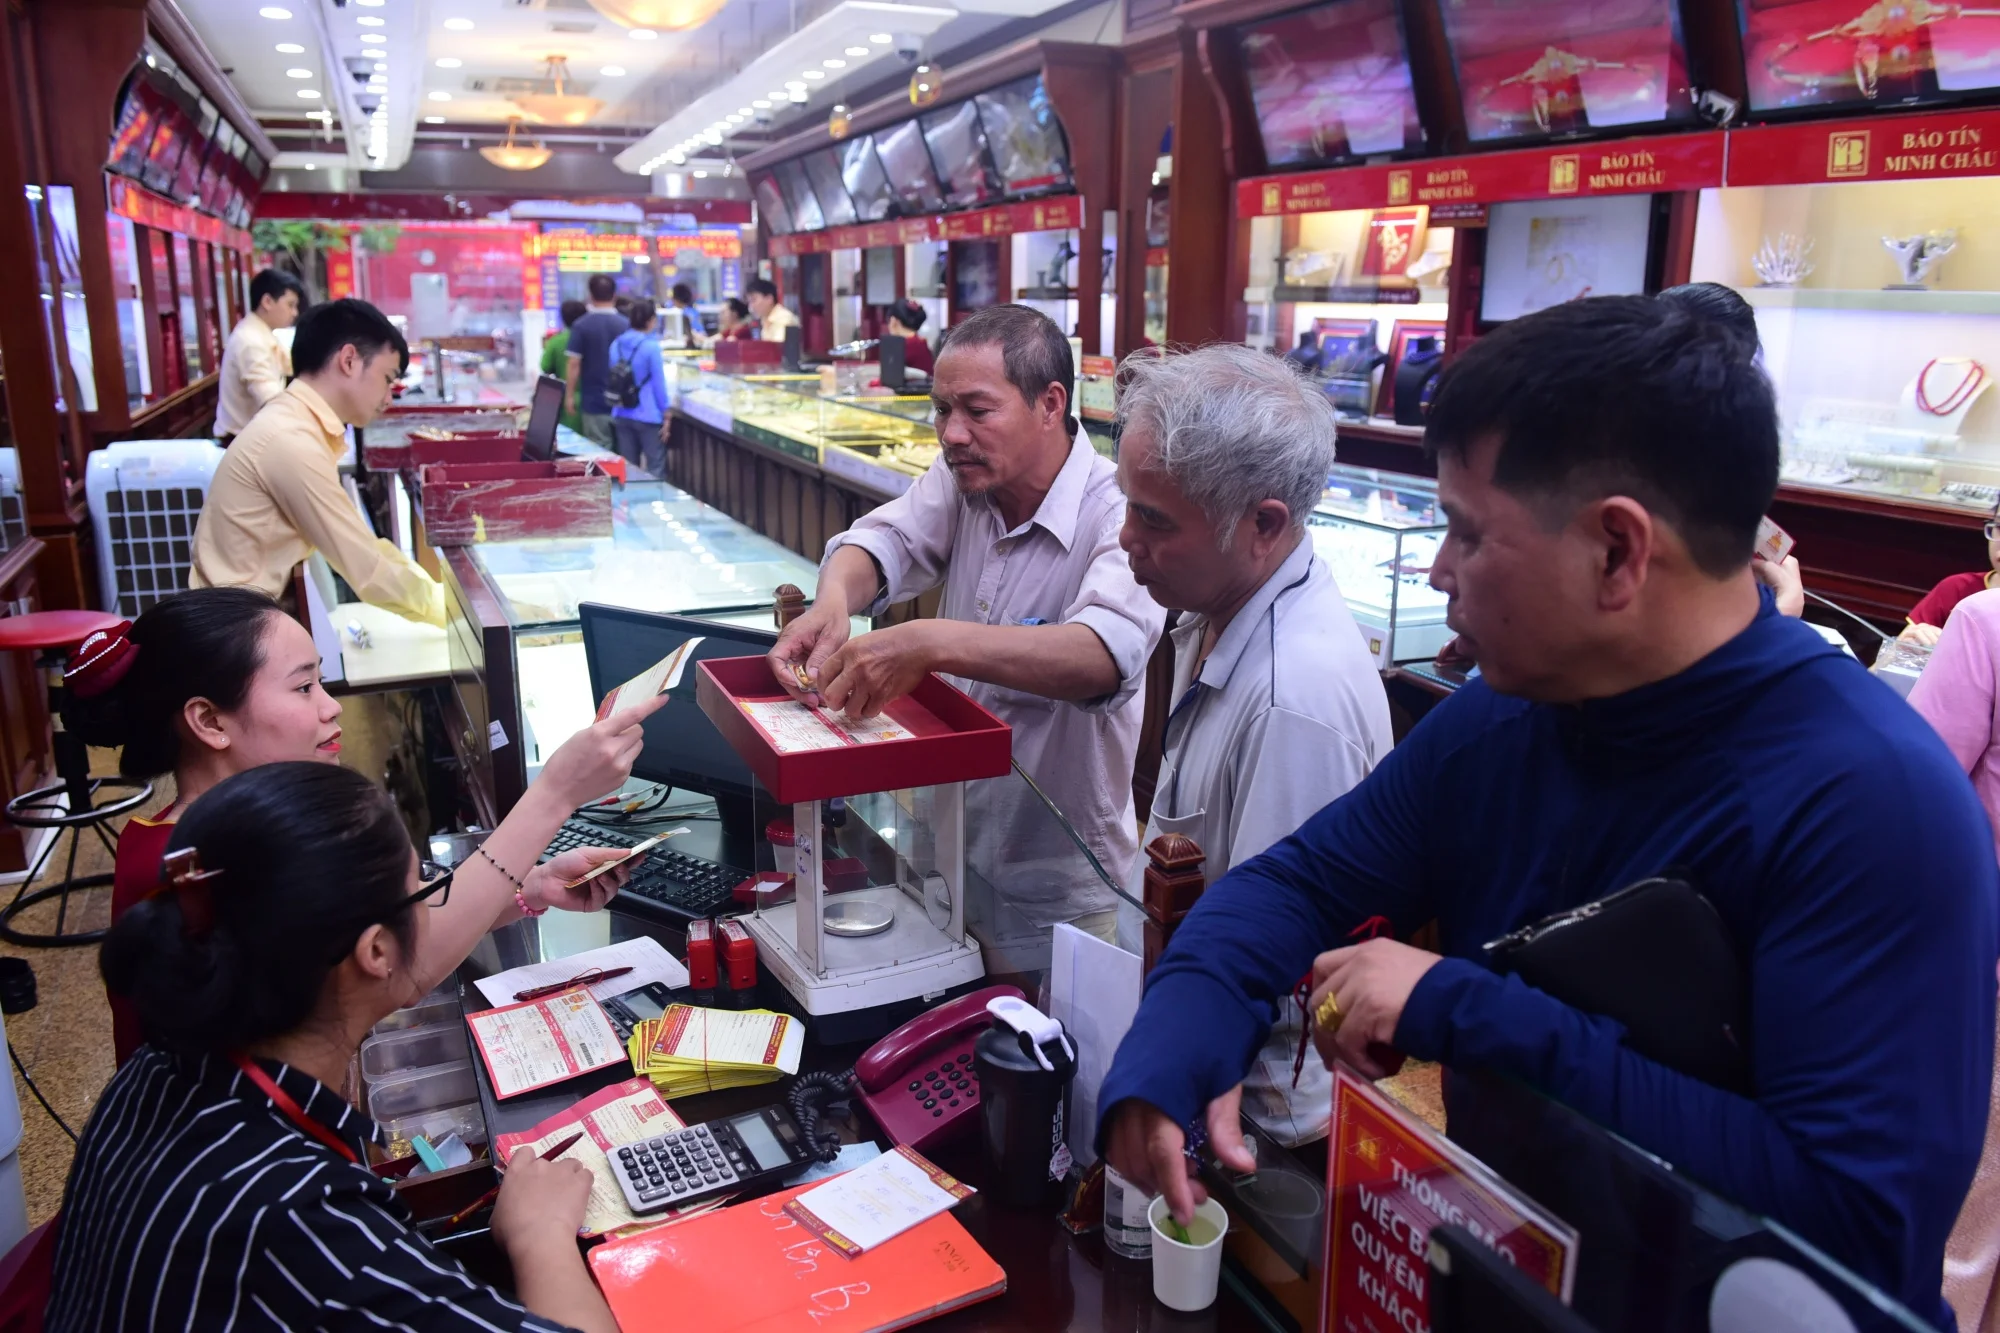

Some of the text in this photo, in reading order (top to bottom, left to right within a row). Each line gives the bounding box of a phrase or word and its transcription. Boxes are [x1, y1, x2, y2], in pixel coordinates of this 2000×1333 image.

[1946, 124, 1983, 147] TÍN
[1884, 147, 1998, 173] MINH CHÂU
[1588, 173, 1625, 189] MINH
[1390, 1156, 1464, 1226] THÔNG
[1358, 1183, 1405, 1242] VIỆC
